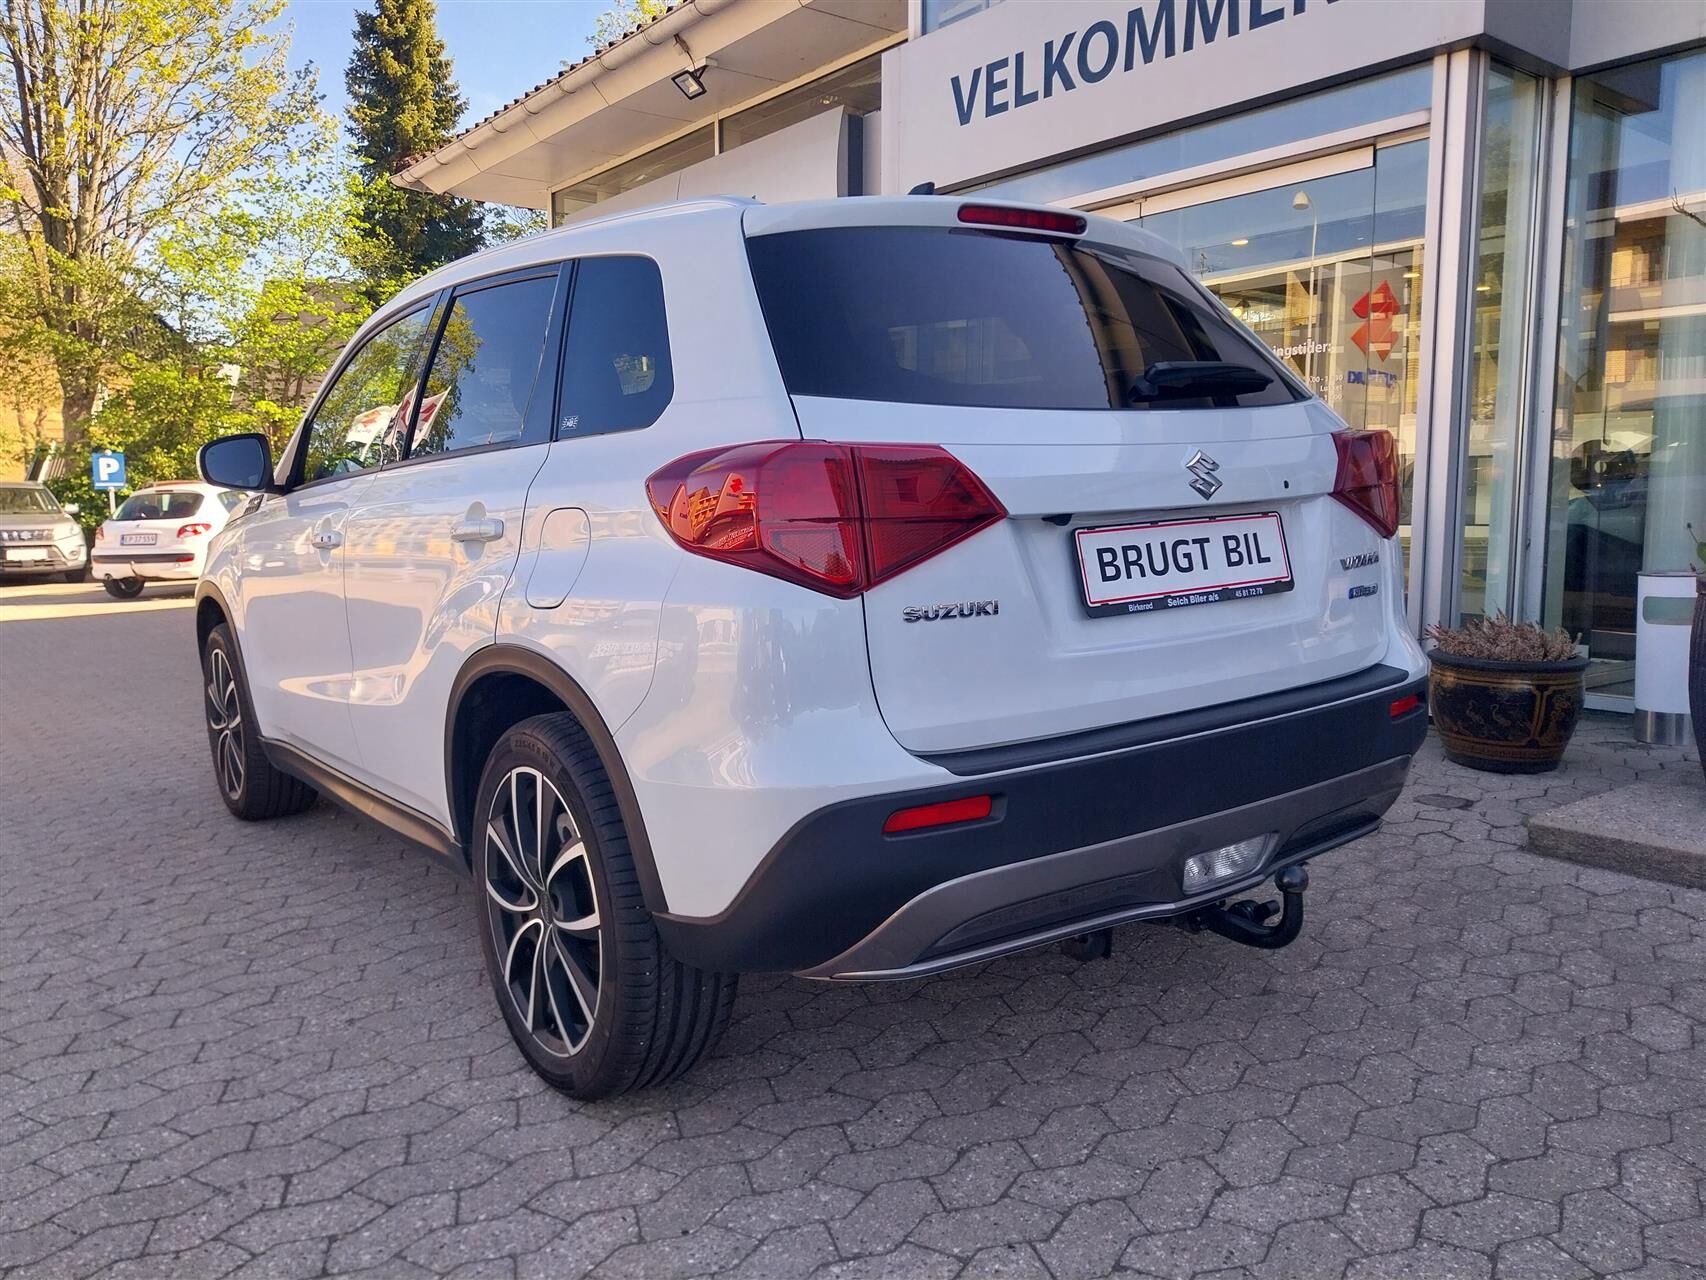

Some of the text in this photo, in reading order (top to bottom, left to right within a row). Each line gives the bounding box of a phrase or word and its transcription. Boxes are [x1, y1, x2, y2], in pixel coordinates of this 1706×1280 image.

[950, 0, 1339, 127] VELKOMM
[1272, 340, 1332, 359] ingstider:
[98, 457, 120, 481] P
[1096, 532, 1271, 582] BRUGT BIL
[1167, 596, 1189, 607] Selch
[1189, 594, 1207, 604] Biler
[1208, 592, 1219, 602] a/s
[903, 600, 999, 623] SUZUKI
